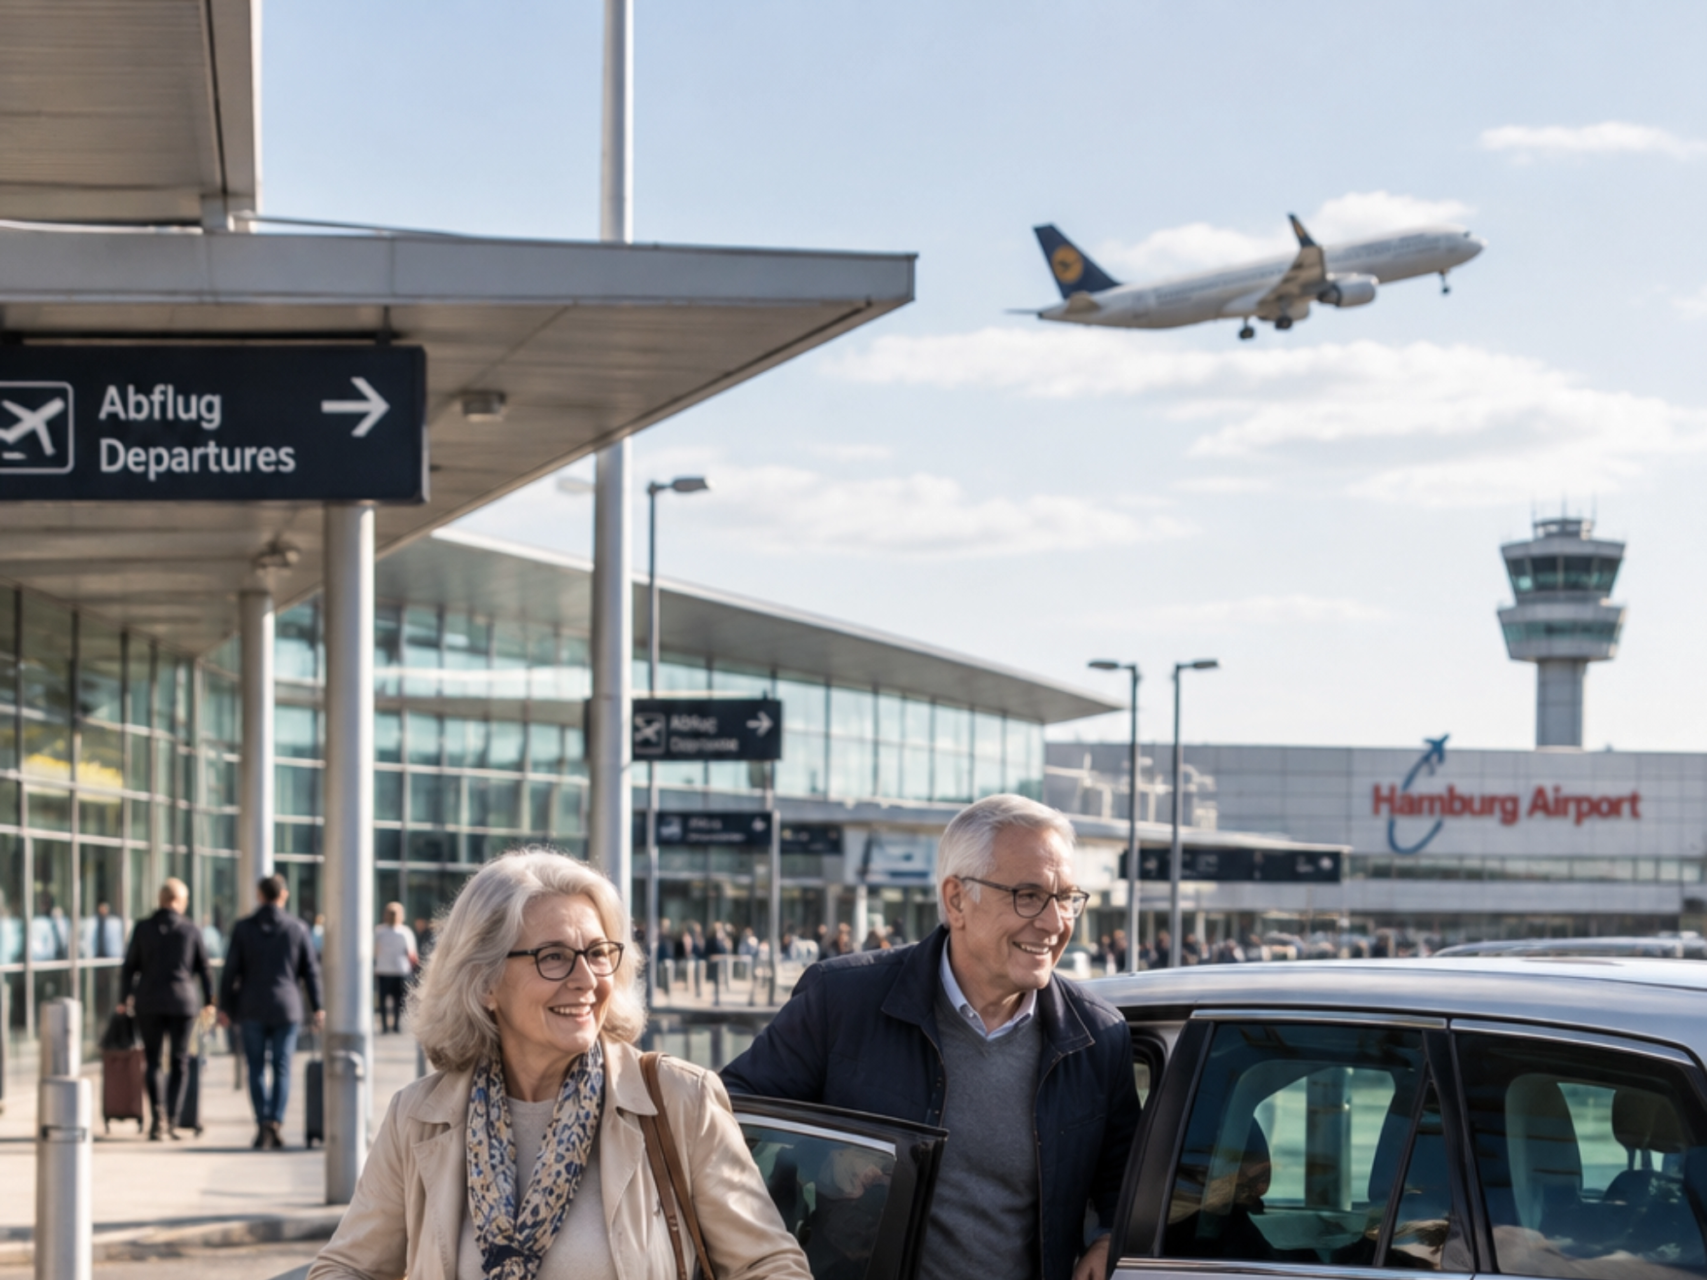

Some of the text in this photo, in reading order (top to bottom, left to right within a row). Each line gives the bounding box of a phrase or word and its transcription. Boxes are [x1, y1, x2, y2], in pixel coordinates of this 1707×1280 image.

[99, 384, 222, 429] Abflug
[100, 438, 296, 481] Departures
[1372, 783, 1641, 826] Hamburg Airport
